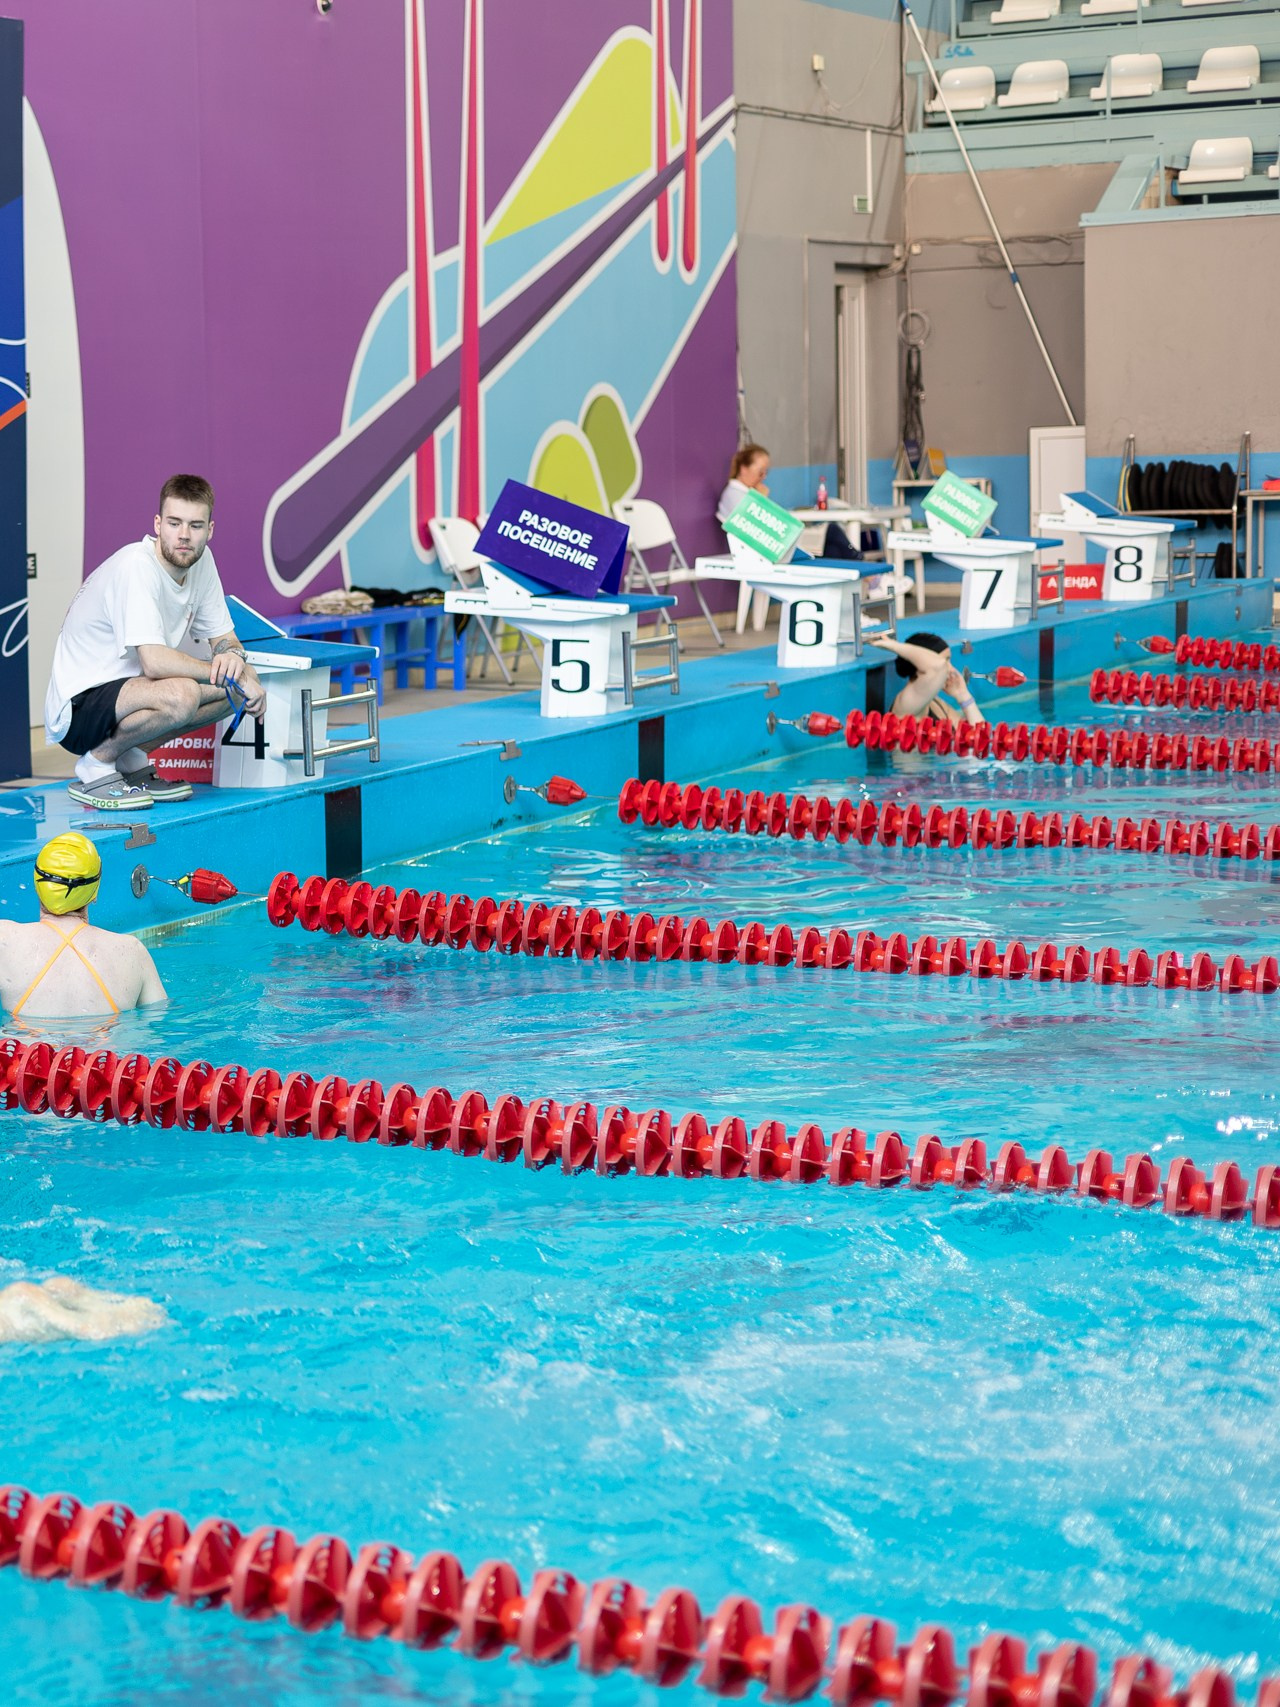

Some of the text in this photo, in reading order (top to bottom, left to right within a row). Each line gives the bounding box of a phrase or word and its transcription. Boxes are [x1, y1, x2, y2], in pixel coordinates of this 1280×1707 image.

[518, 509, 593, 549] РАЗОВОЕ
[929, 494, 980, 530] АБОНЕМЕНТ
[497, 520, 599, 571] ПОСЕЩЕНИЕ
[730, 513, 785, 555] АБОНЕМЕНТ
[1047, 576, 1098, 589] АЕНДА
[1114, 546, 1143, 582] 8
[973, 568, 1004, 610] 7
[789, 600, 824, 647] 6
[551, 638, 590, 693] 5
[221, 710, 270, 759] 4
[91, 798, 119, 808] crocs
